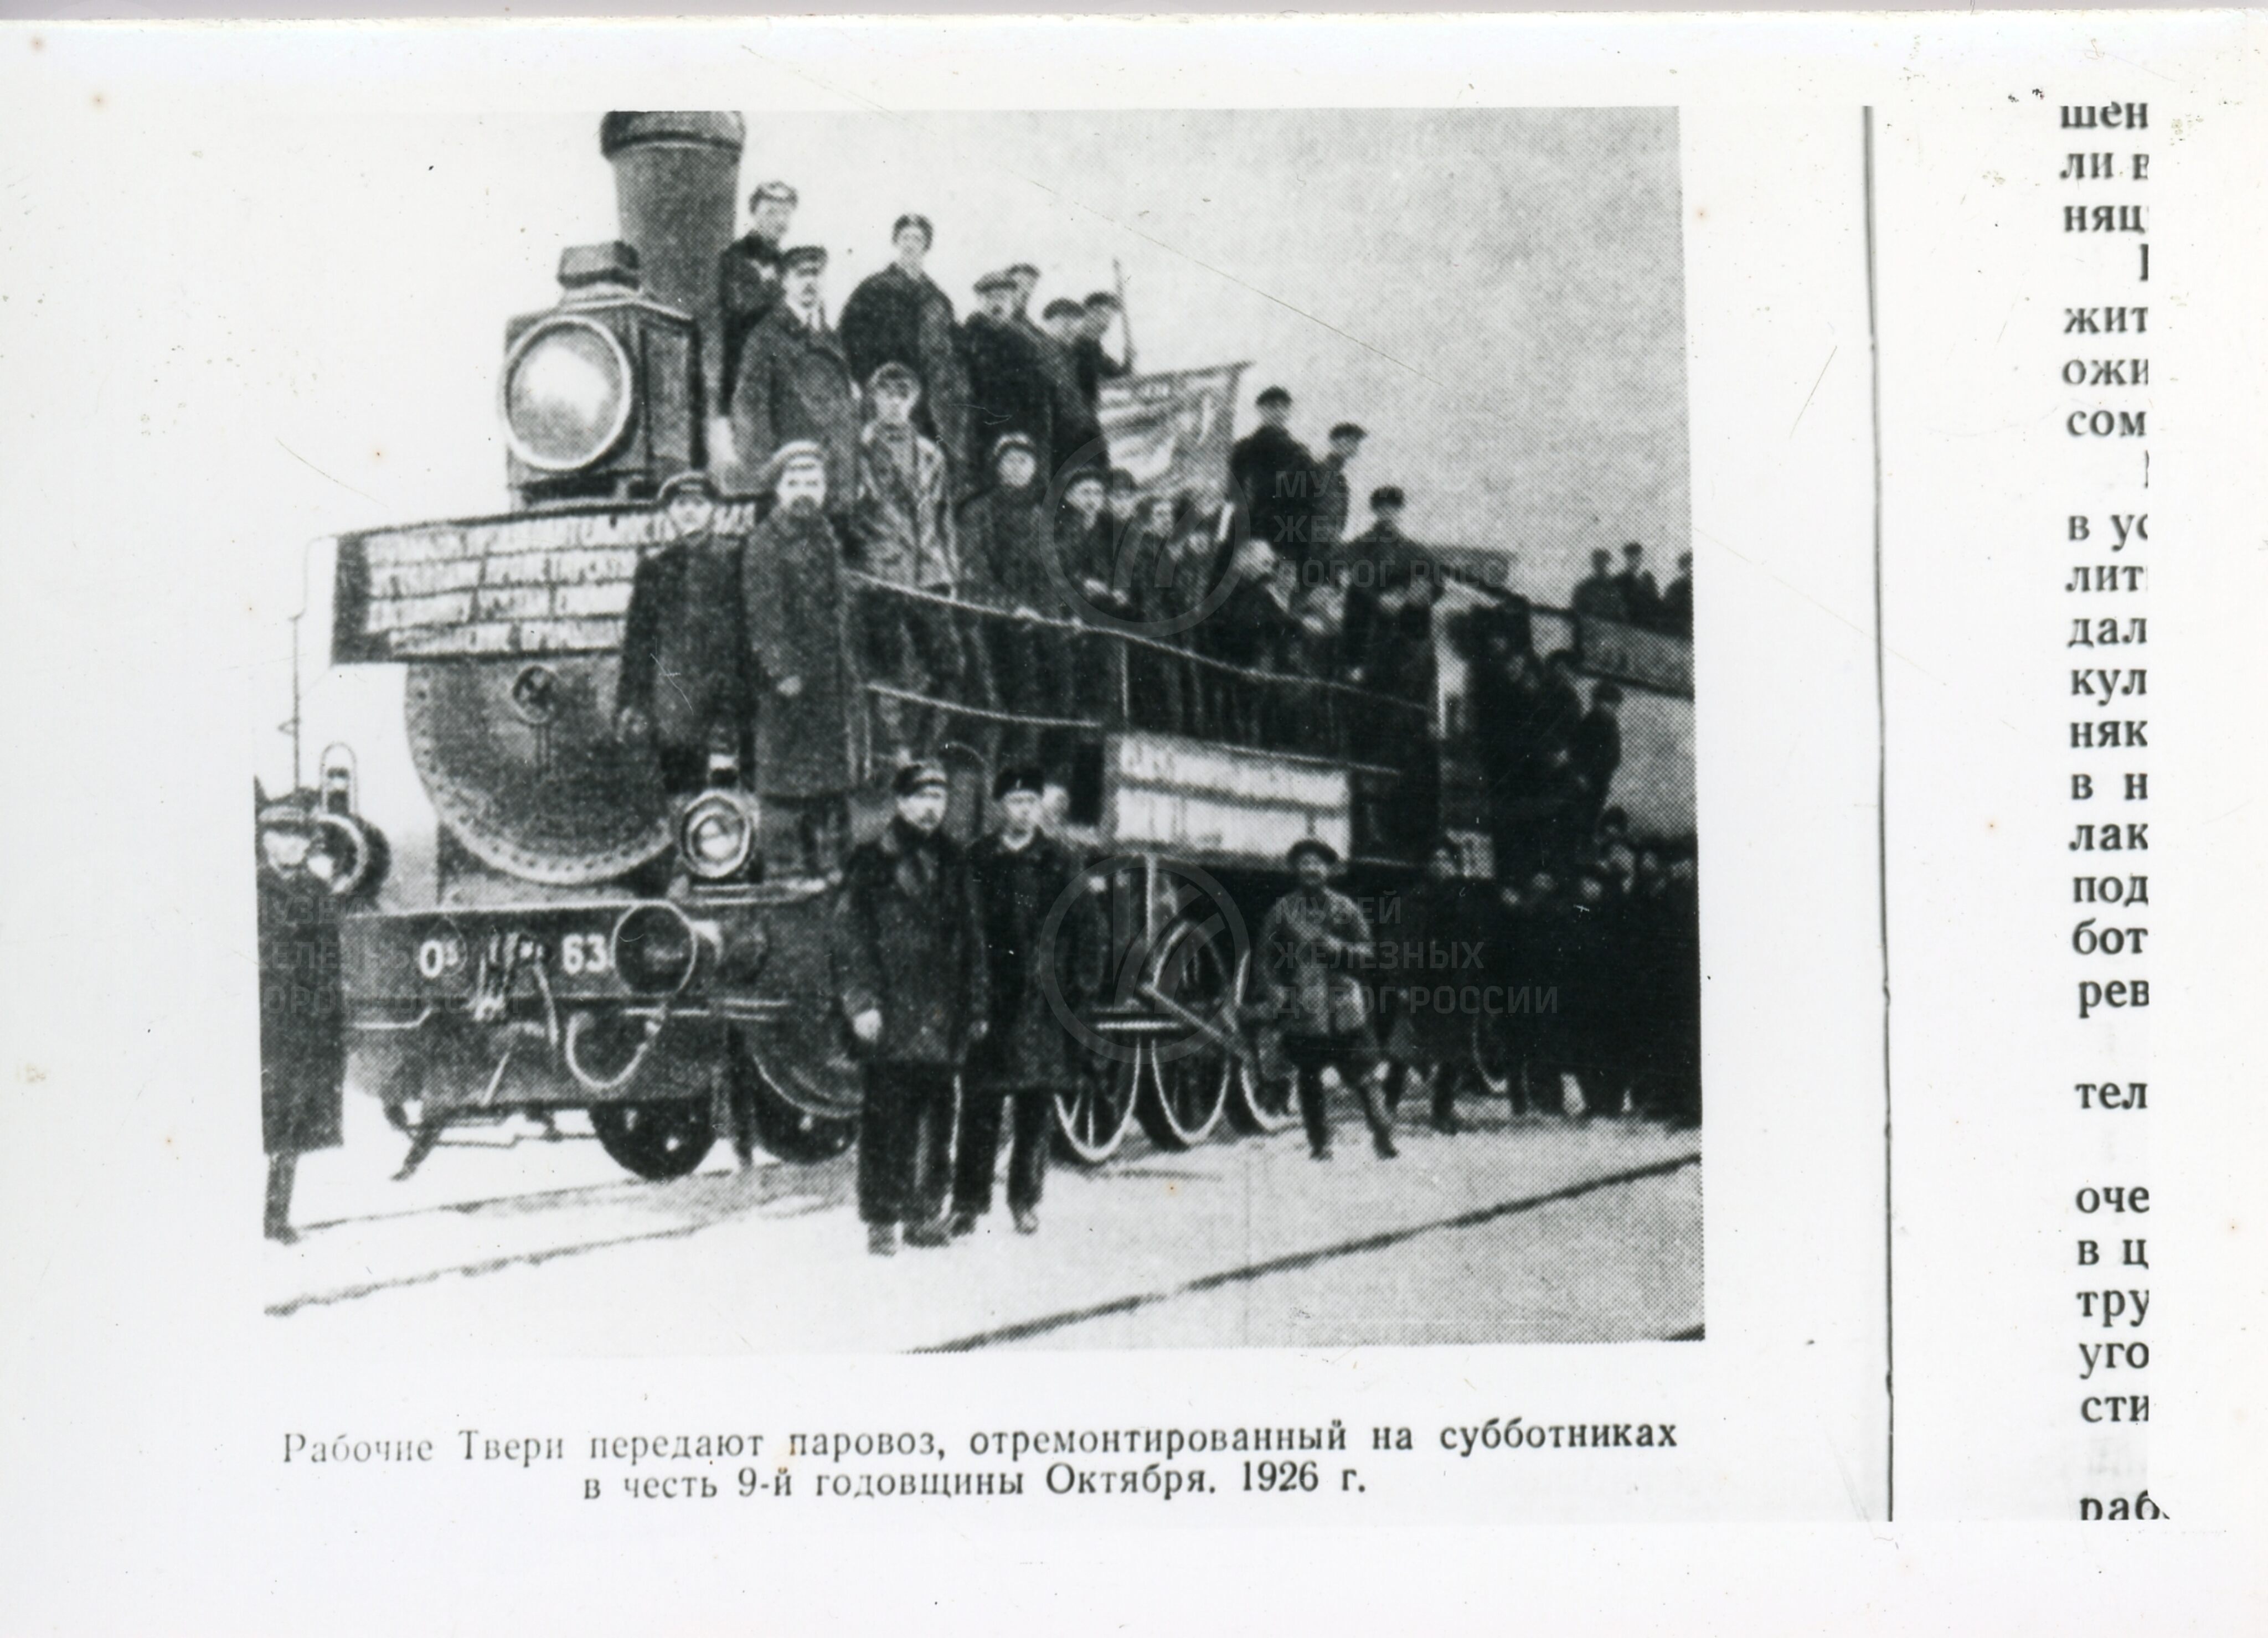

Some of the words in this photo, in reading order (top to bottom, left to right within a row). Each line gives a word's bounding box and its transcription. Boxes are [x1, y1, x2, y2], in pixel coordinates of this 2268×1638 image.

[2060, 101, 2149, 130] шен
[2059, 152, 2114, 180] ли
[2064, 205, 2146, 234] няц
[2064, 306, 2148, 334] жит
[2066, 410, 2146, 437] сом
[2068, 515, 2090, 541] в
[2065, 565, 2145, 593] лит
[2067, 617, 2147, 648] дал
[2071, 668, 2148, 707] кул
[2070, 720, 2148, 749] няк
[2071, 773, 2094, 801] в
[2124, 772, 2148, 802] н
[2068, 823, 2149, 852] лак
[2073, 875, 2150, 908] под
[2071, 917, 2149, 955] бот
[562, 933, 609, 976] 63
[2078, 979, 2150, 1020] рев
[2074, 1082, 2148, 1110] тел
[2075, 1186, 2151, 1215] оче
[2077, 1239, 2100, 1266] в
[2122, 1238, 2150, 1270] ц
[2075, 1289, 2150, 1329] тру
[2078, 1341, 2150, 1381] уго
[283, 1430, 434, 1464] Рабочие
[458, 1429, 564, 1469] Твери
[590, 1434, 764, 1462] передают
[788, 1431, 946, 1464] паровоз,
[969, 1418, 1347, 1463] отремонтированный
[1372, 1425, 1414, 1451] на
[1439, 1415, 1678, 1458] субботниках
[583, 1478, 602, 1501] в
[623, 1476, 718, 1500] честь
[737, 1466, 792, 1498] 9-й
[815, 1471, 1024, 1499] годовщины
[1045, 1461, 1217, 1502] Октября.
[1242, 1459, 1319, 1493] 1926
[1341, 1468, 1367, 1494] г.
[2079, 1488, 2171, 1521] раб
